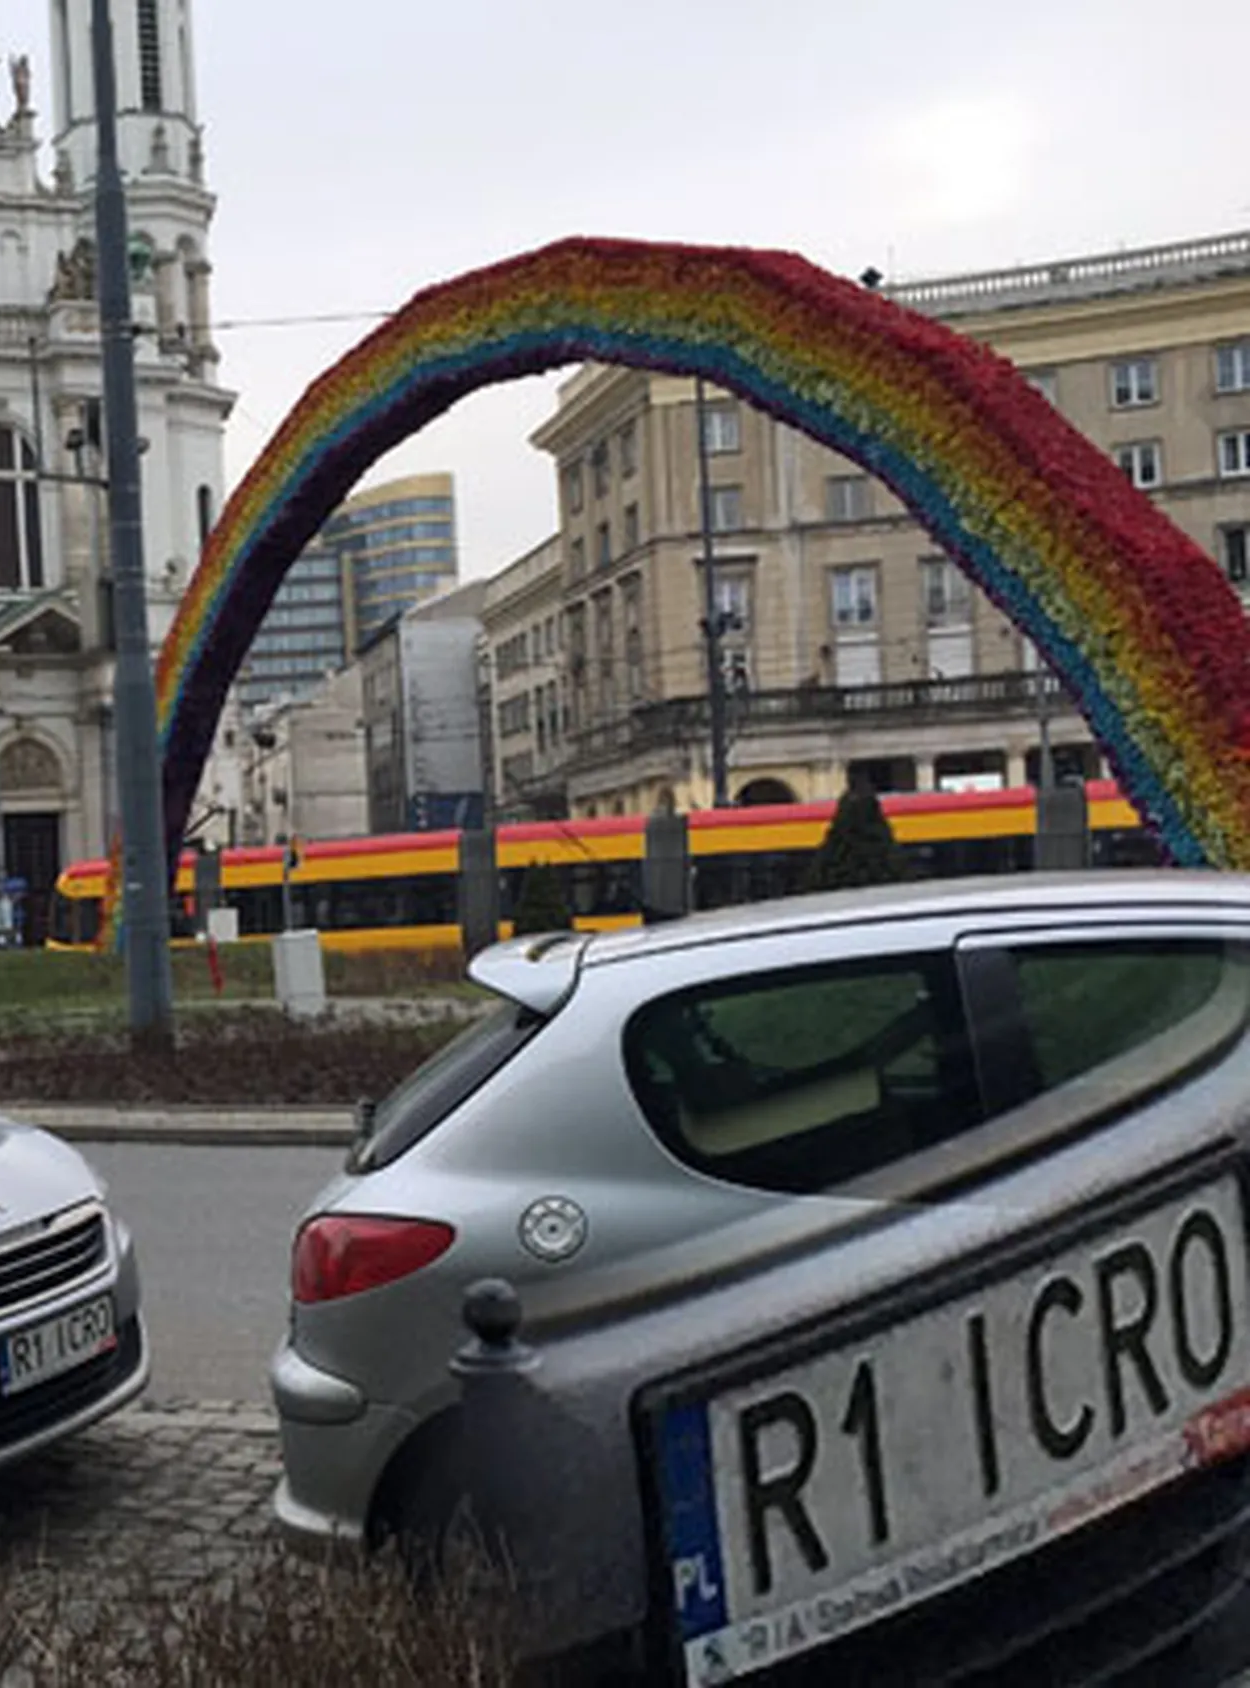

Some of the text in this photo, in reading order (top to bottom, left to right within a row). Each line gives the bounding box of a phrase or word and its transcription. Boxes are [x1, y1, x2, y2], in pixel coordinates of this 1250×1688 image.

[12, 1301, 110, 1378] R1 ICRO
[738, 1360, 890, 1596] R1
[965, 1209, 1234, 1499] ICRO
[674, 1552, 718, 1610] PL
